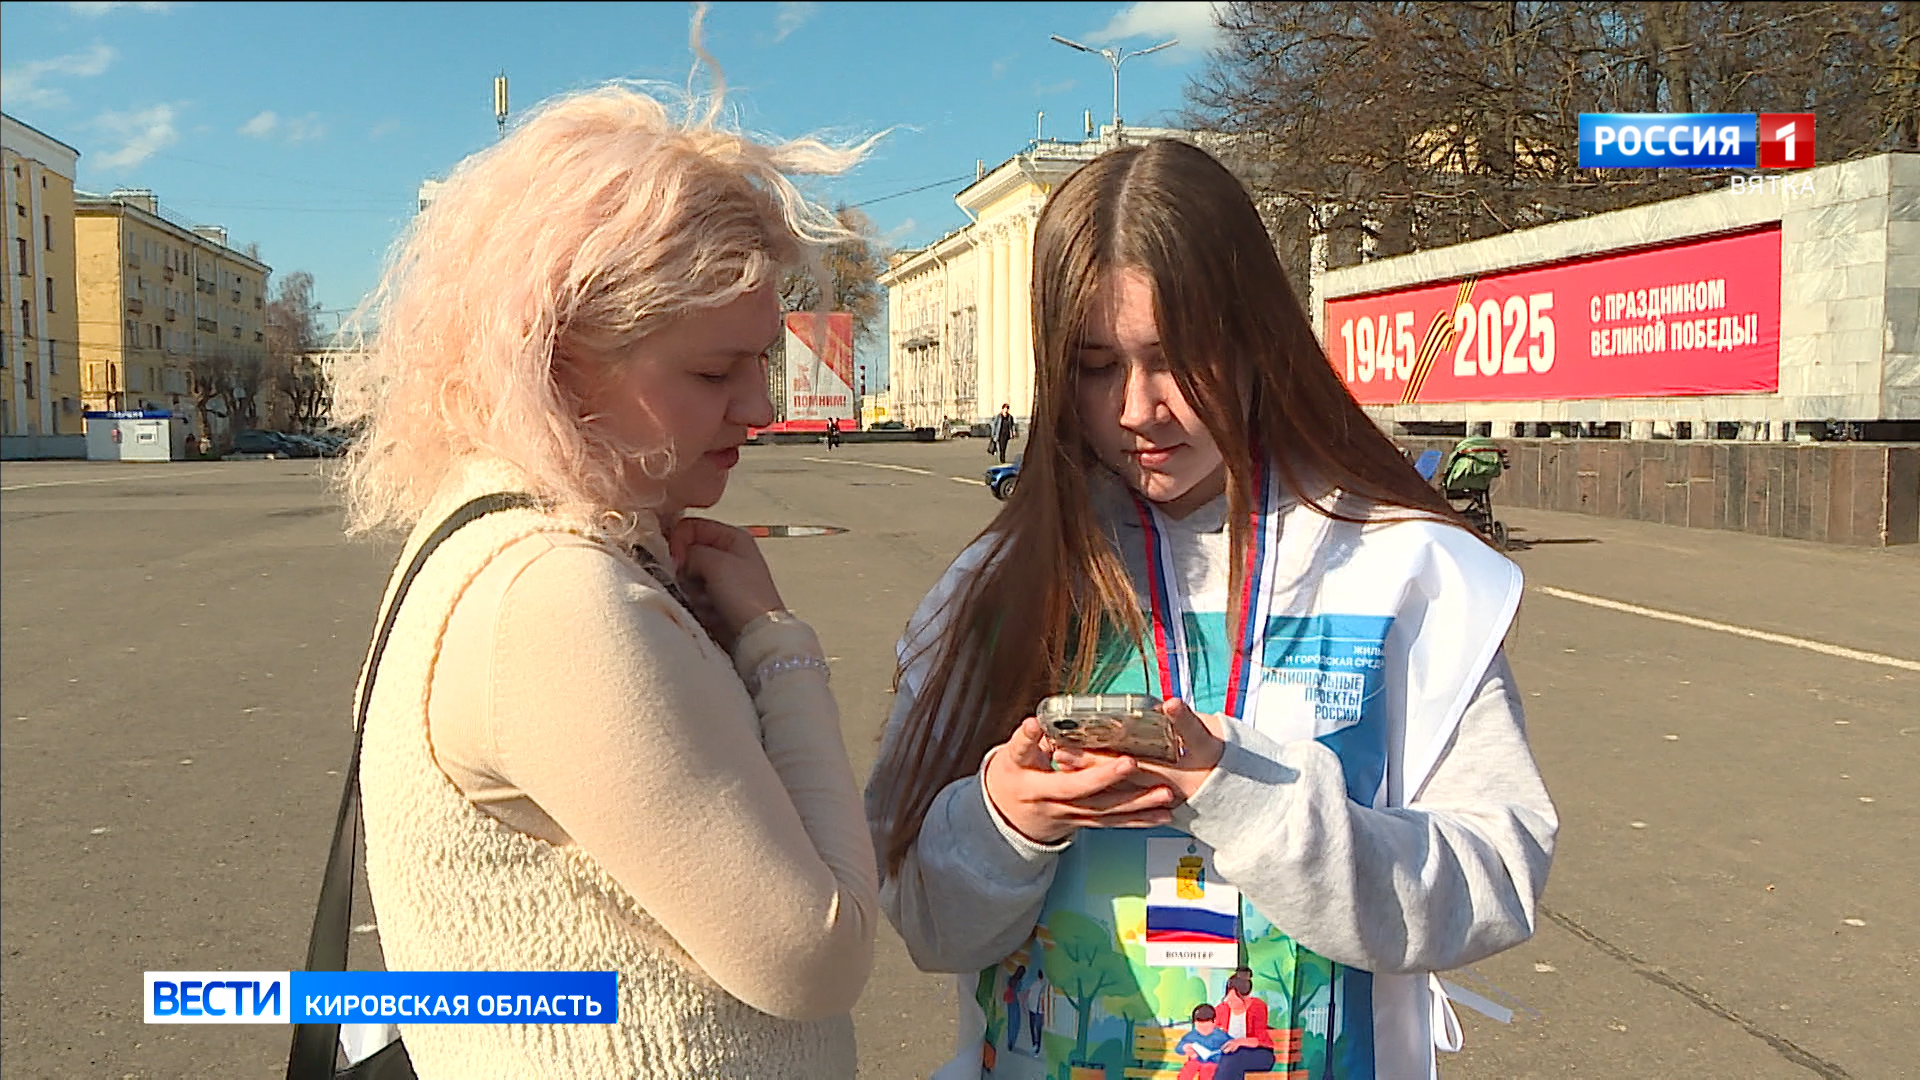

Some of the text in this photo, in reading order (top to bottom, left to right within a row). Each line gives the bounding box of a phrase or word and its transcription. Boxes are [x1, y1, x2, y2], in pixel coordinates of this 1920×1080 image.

[1590, 279, 1726, 323] С ПРАЗДНИКОМ
[1341, 292, 1556, 383] 1945 2025
[1590, 313, 1758, 358] ВЕЛИКОЙ ПОБЕДЫ!
[793, 395, 847, 408] ПОМНИМ!
[1262, 670, 1362, 692] НАЦИОНАЛЬНЫЕ
[1304, 686, 1360, 706] ПРОЕКТЫ
[1314, 705, 1358, 722] РОССИИ
